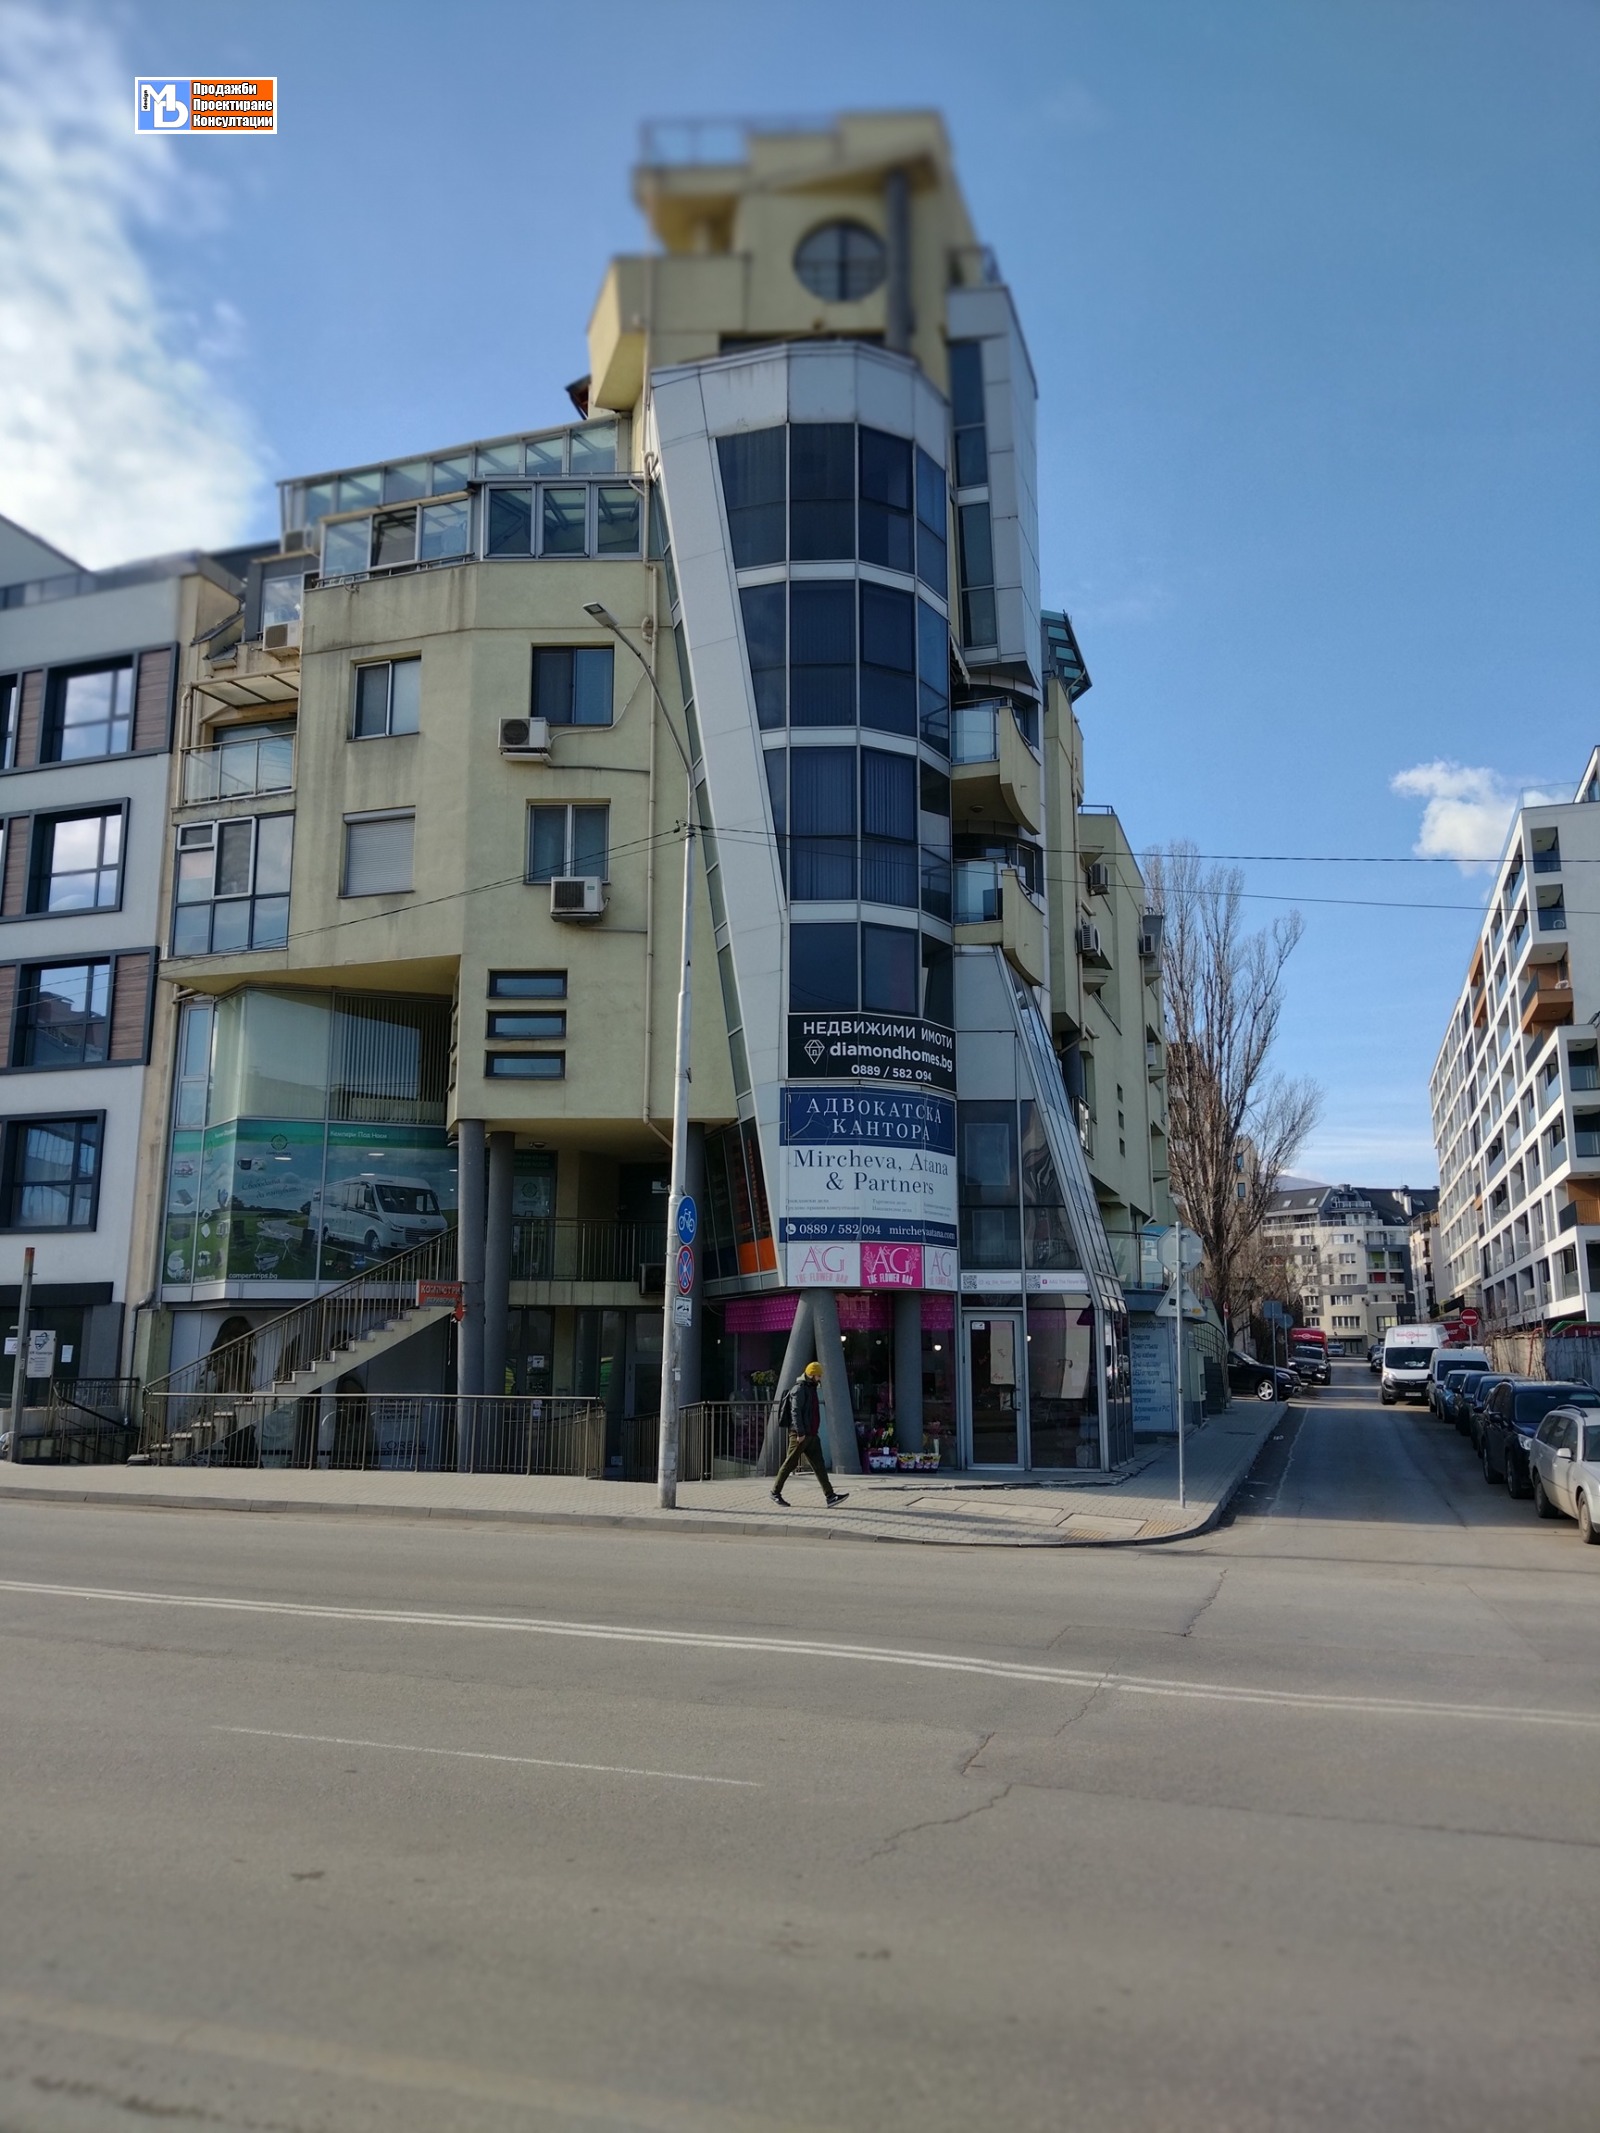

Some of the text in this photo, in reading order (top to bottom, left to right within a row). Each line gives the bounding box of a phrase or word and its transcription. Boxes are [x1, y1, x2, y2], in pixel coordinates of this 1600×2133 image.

[803, 1020, 953, 1050] НЕДВИЖИМИ ИМОТИ
[830, 1041, 953, 1072] diamondhomes.bg
[851, 1064, 932, 1082] 0889 / 582 094
[806, 1097, 942, 1124] АДВОКАТСКА
[832, 1118, 930, 1141] КАНТОРА
[793, 1149, 949, 1176] Mircheva, Atana
[826, 1171, 934, 1195] & Partners
[800, 1224, 828, 1234] 0889
[830, 1224, 835, 1235] /
[838, 1224, 859, 1235] 582
[862, 1224, 881, 1235] 094
[795, 1272, 848, 1284] THE FLOWER BAR
[866, 1272, 914, 1286] THE FLOWER BAR
